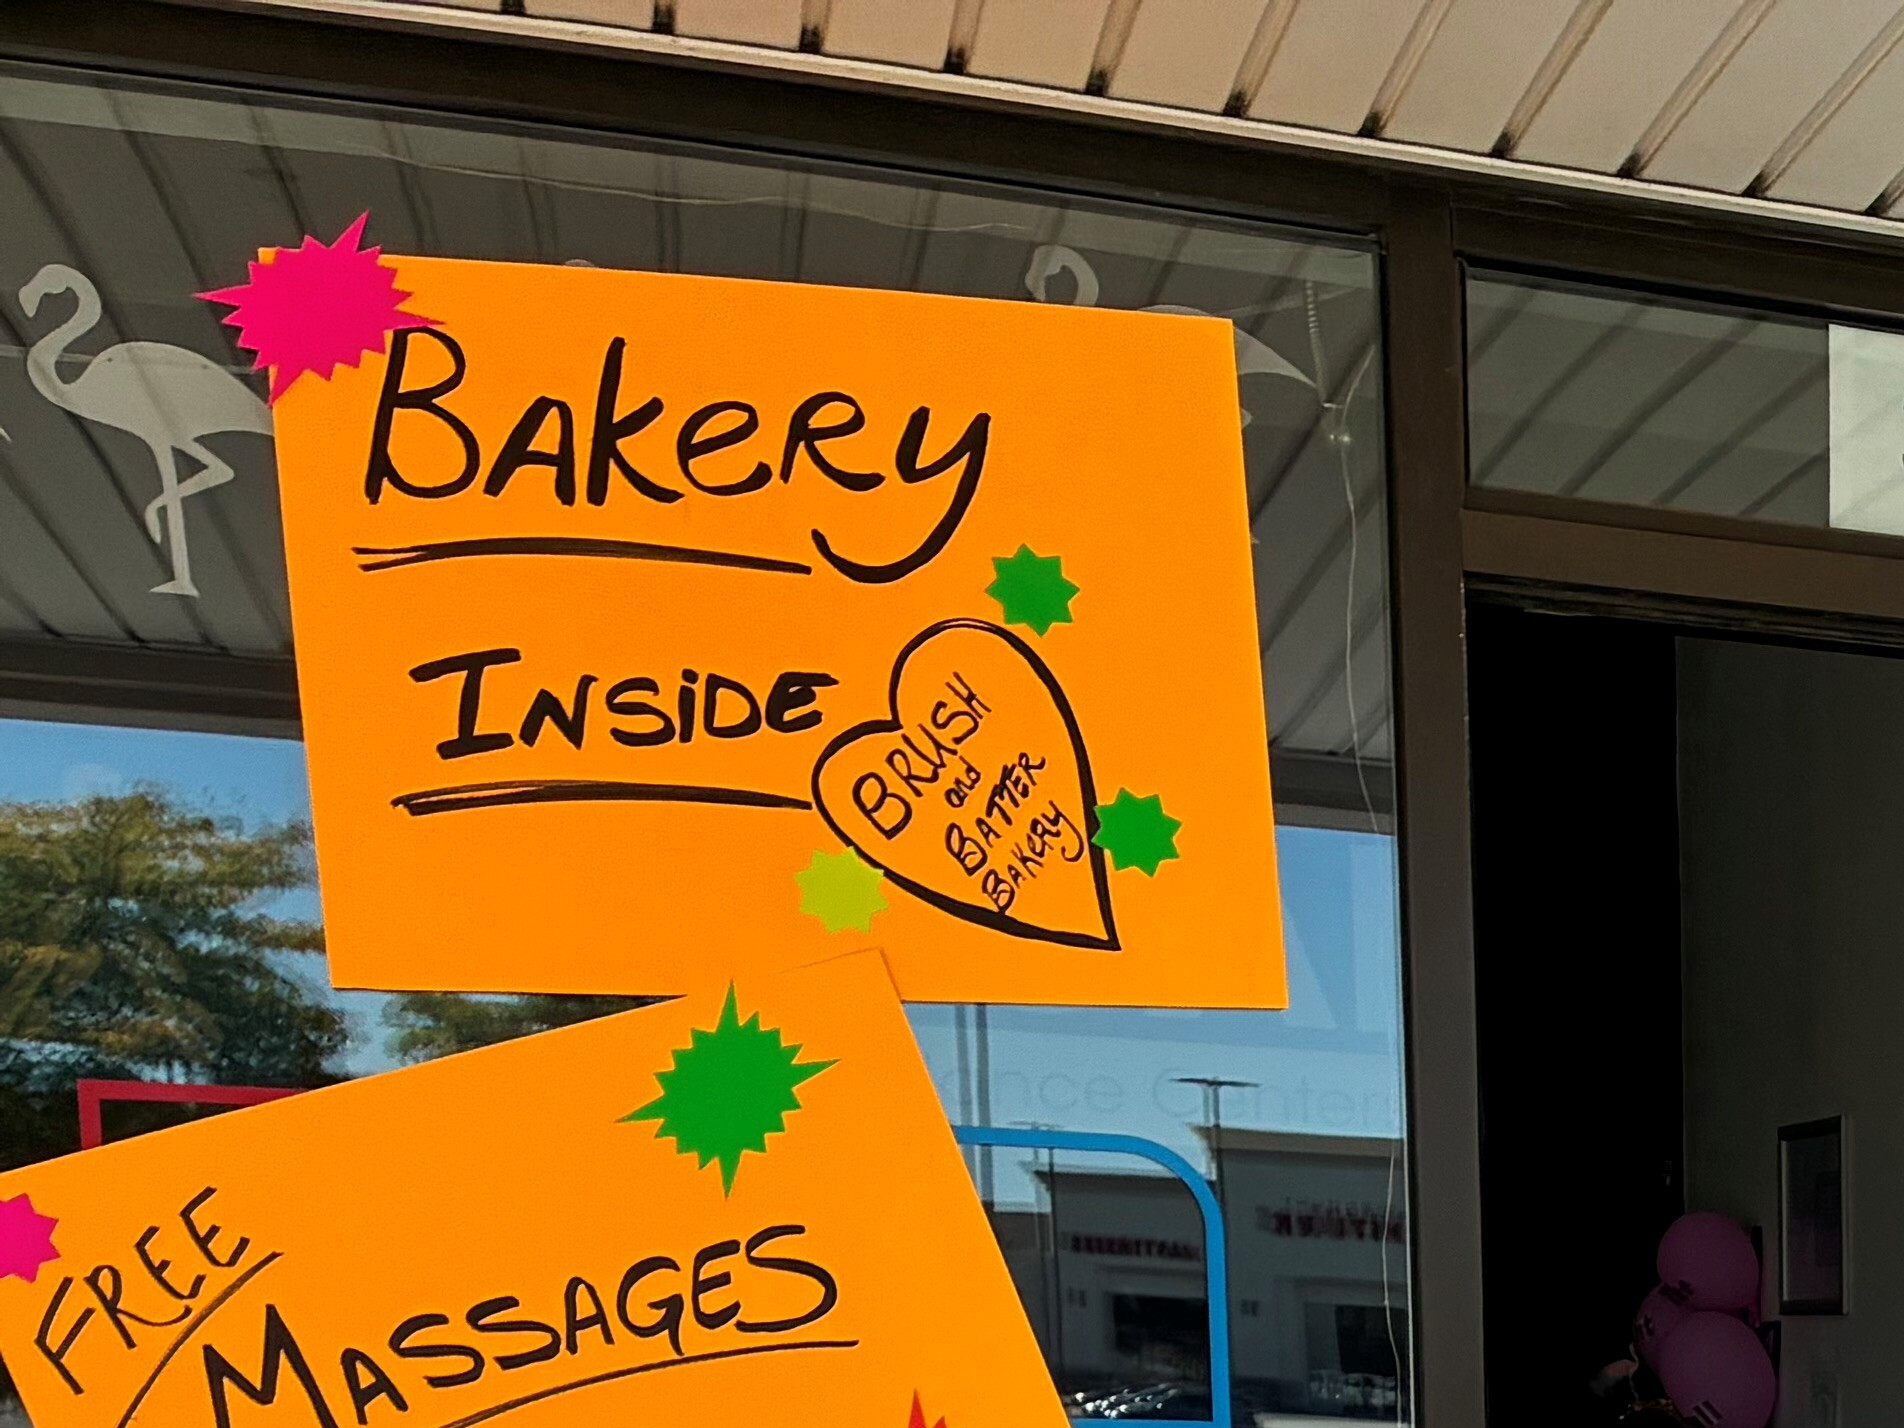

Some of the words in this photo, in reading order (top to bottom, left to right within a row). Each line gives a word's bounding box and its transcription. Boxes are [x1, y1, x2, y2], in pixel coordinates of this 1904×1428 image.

[852, 671, 993, 841] BRUSH
[944, 755, 982, 809] and
[944, 751, 1047, 878] BATTER
[33, 1187, 252, 1395] FREE
